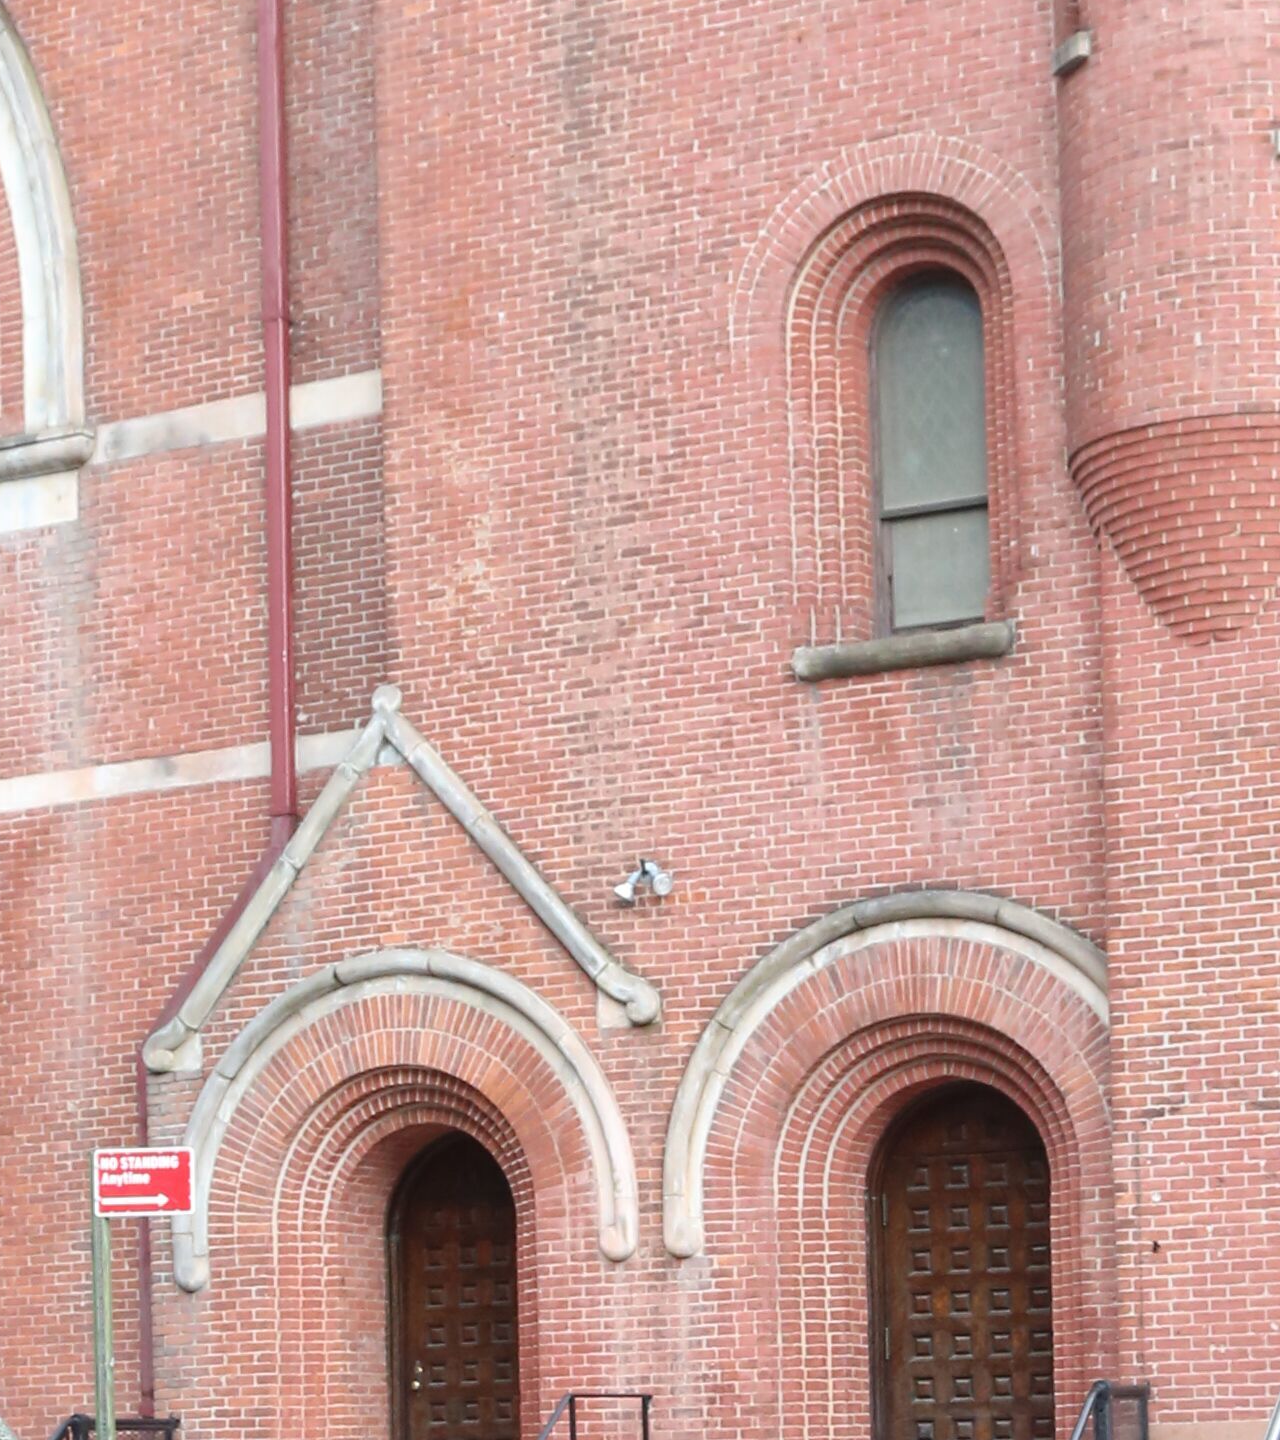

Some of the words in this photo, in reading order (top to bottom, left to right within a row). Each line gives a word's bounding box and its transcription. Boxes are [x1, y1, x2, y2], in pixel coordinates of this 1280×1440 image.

[100, 1156, 119, 1170] NO
[120, 1155, 180, 1171] STANDING
[100, 1171, 151, 1187] Anytime
